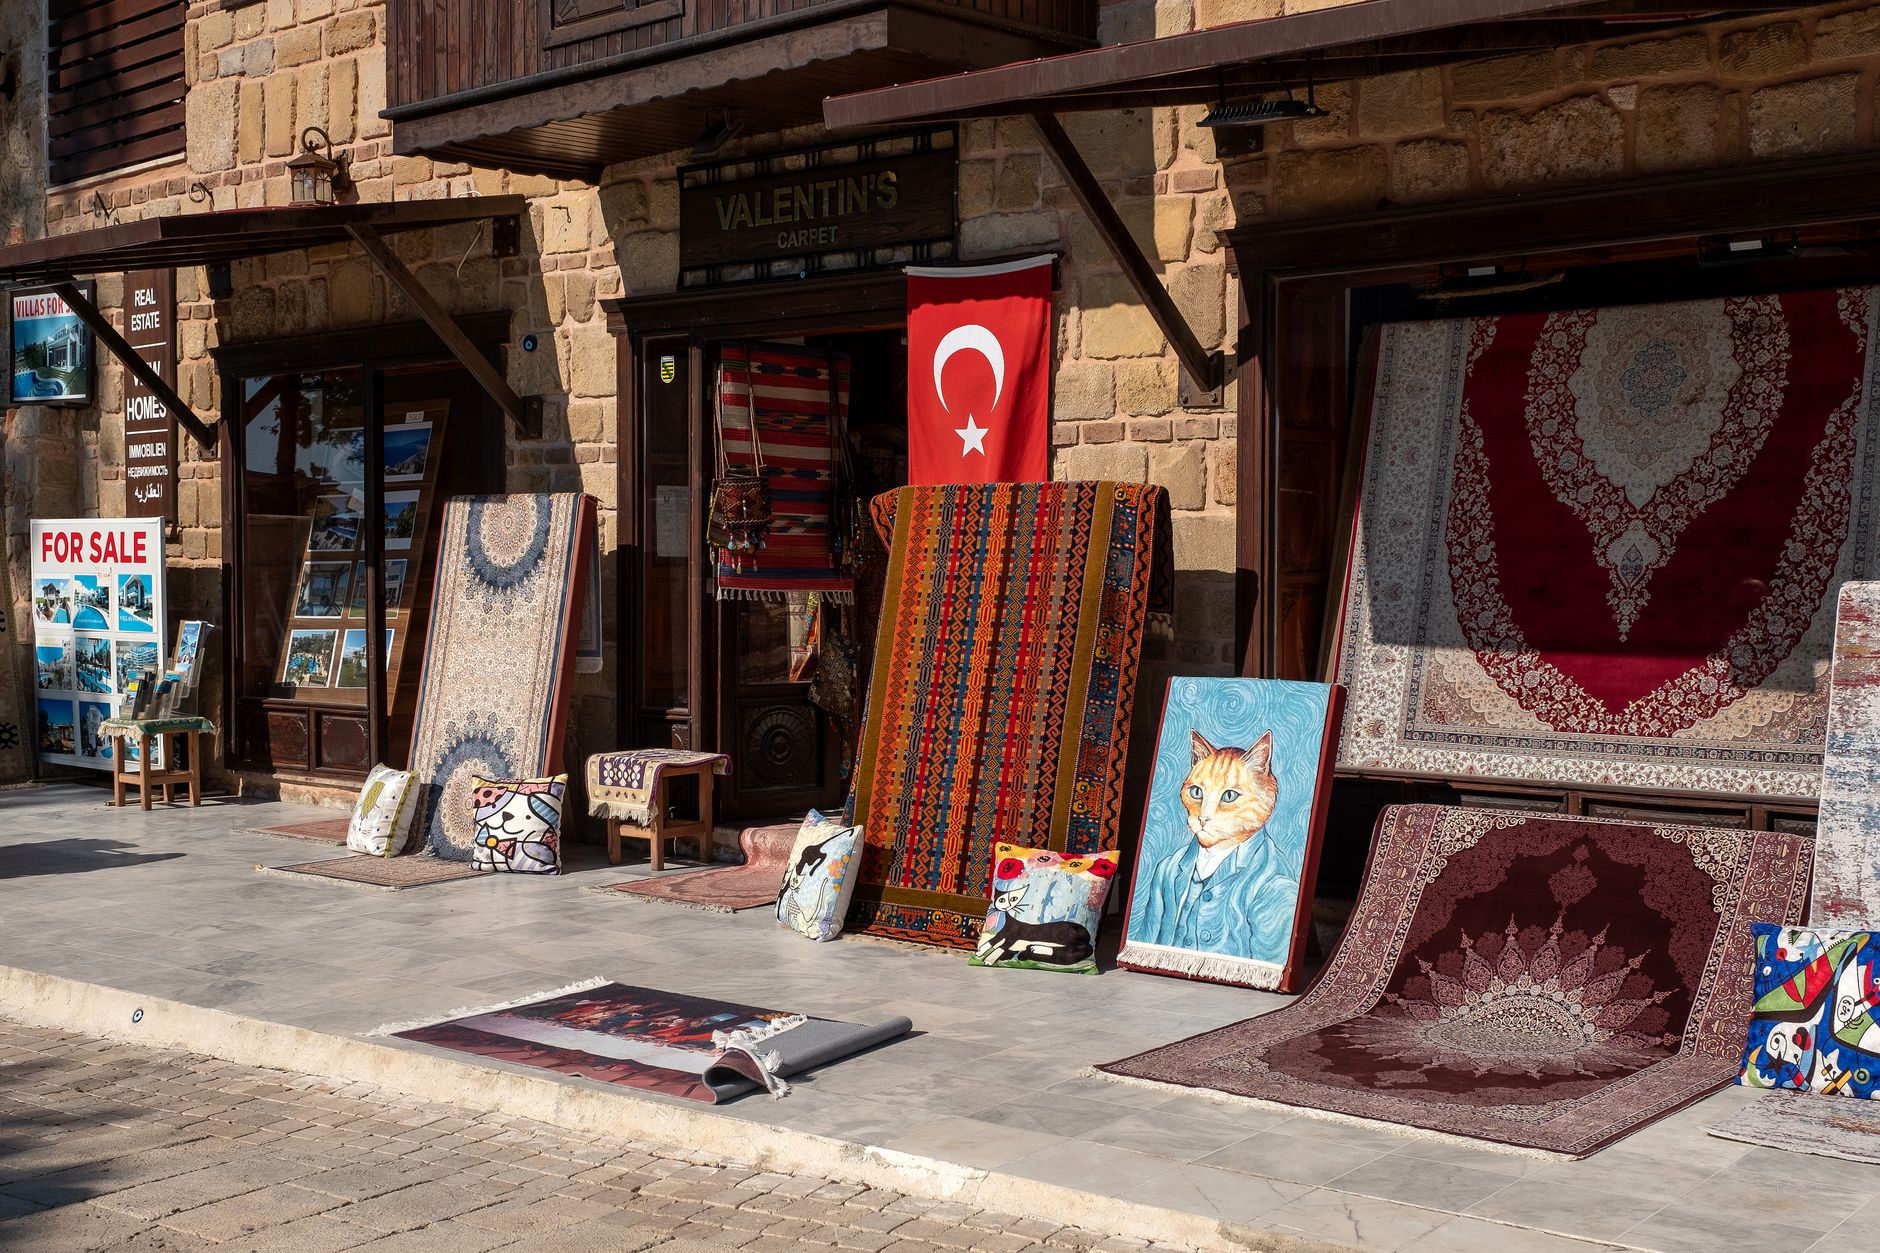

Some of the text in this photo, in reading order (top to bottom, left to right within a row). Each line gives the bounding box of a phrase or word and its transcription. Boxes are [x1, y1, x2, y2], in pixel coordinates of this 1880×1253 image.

[715, 170, 898, 231] VALENTIN'S
[777, 225, 838, 249] CARPET
[15, 297, 45, 318] VILLAS
[46, 295, 64, 315] FOR
[134, 288, 156, 307] REAL
[131, 311, 160, 332] ESTATE
[126, 396, 167, 421] HOMES
[128, 442, 166, 459] IMMOBILIEN
[127, 465, 168, 479] НЕДВИЖИМОСТЬ
[42, 531, 147, 564] FOR SALE
